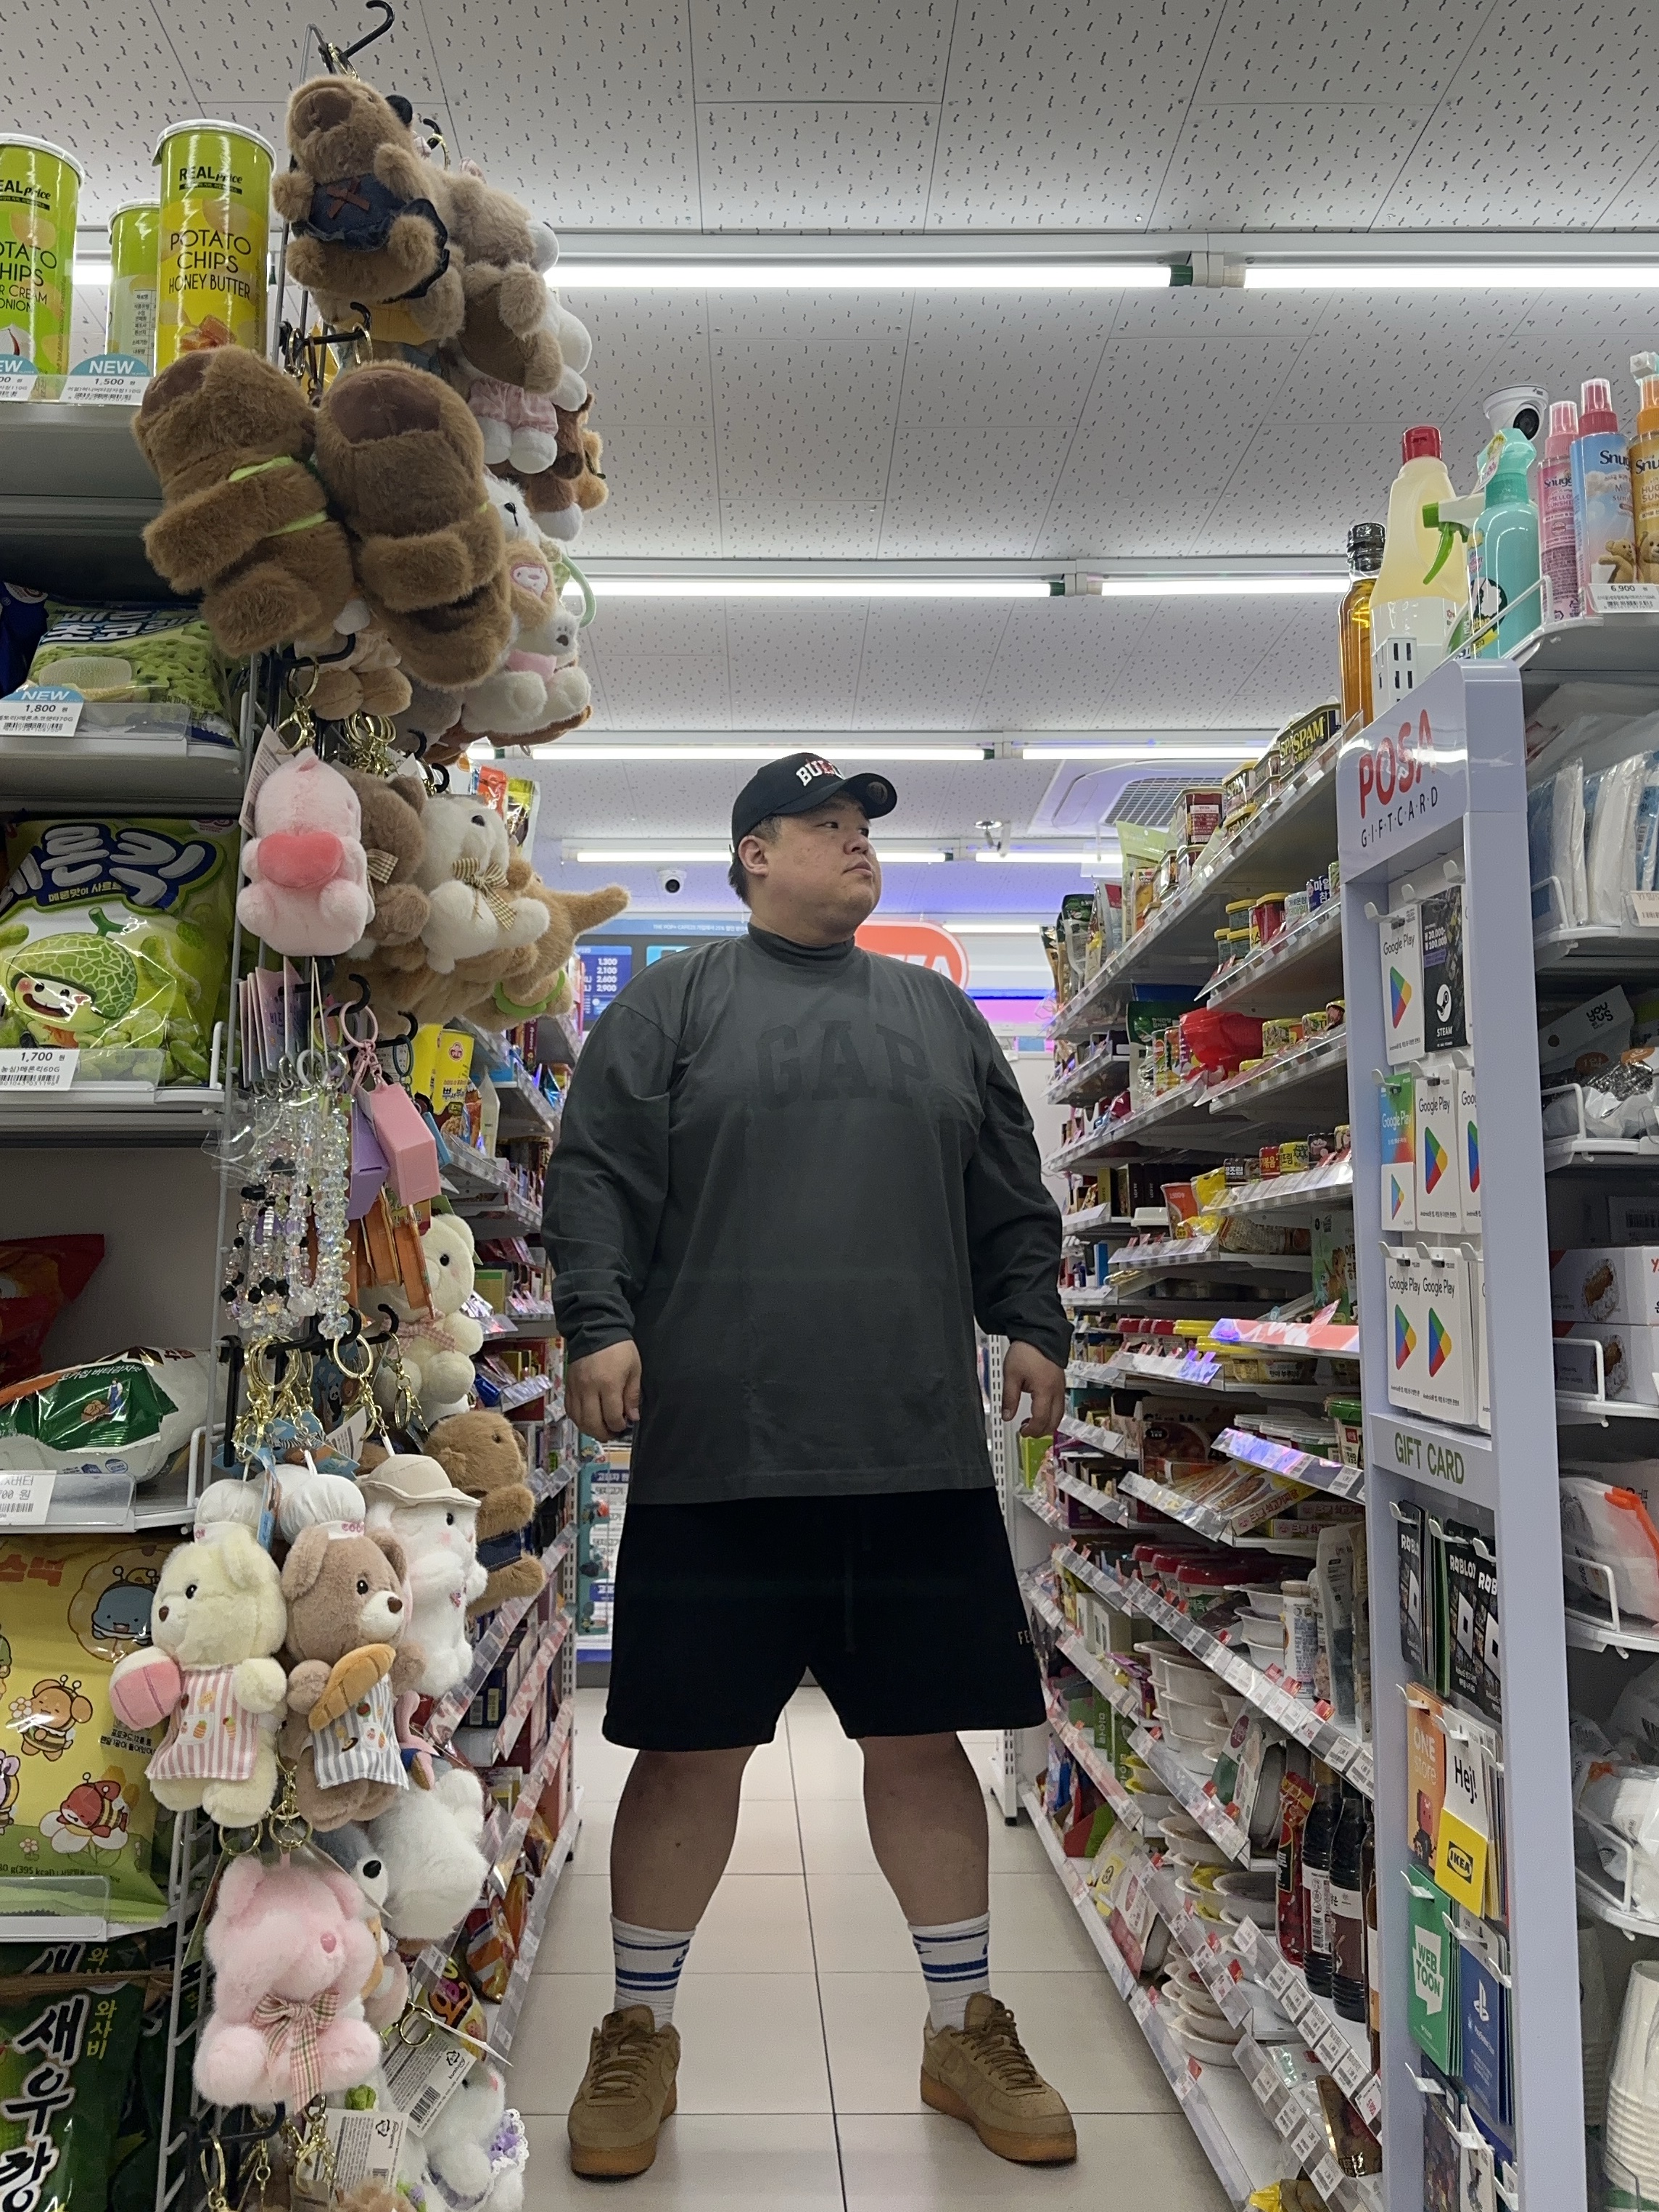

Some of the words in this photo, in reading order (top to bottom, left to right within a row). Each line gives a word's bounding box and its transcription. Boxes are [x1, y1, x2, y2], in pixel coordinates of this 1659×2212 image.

[0, 241, 57, 269] TATO
[170, 229, 252, 255] POTATO
[176, 252, 239, 273] CHIPS
[168, 274, 207, 295] HONEY
[210, 273, 250, 299] BUTTER
[89, 361, 135, 374] NEW
[20, 691, 70, 701] NEW
[1292, 716, 1325, 753] SPAM
[1358, 709, 1436, 818] POSA
[1383, 937, 1403, 955] Google
[1403, 933, 1415, 949] Play
[1436, 1026, 1453, 1037] STEAM
[21, 1052, 53, 1062] 1,700
[756, 1019, 931, 1111] GAP
[1419, 1097, 1438, 1116] Google
[1438, 1096, 1450, 1114] Play
[1382, 1113, 1400, 1130] Google
[1388, 1275, 1408, 1294] Google
[1409, 1277, 1421, 1296] Play
[1423, 1277, 1442, 1297] Google
[1443, 1279, 1455, 1299] Play
[1394, 1431, 1423, 1470] GIFT
[1427, 1442, 1465, 1485] CARD
[19, 1489, 30, 1500] 원
[1415, 1726, 1436, 1763] ONE
[1415, 1756, 1436, 1786] store
[1454, 1755, 1478, 1804] Hej!
[1450, 1851, 1470, 1875] IKEA
[1418, 1943, 1437, 1975] WEB
[1416, 1959, 1441, 1997] TOON
[86, 1999, 117, 2060] 와사비
